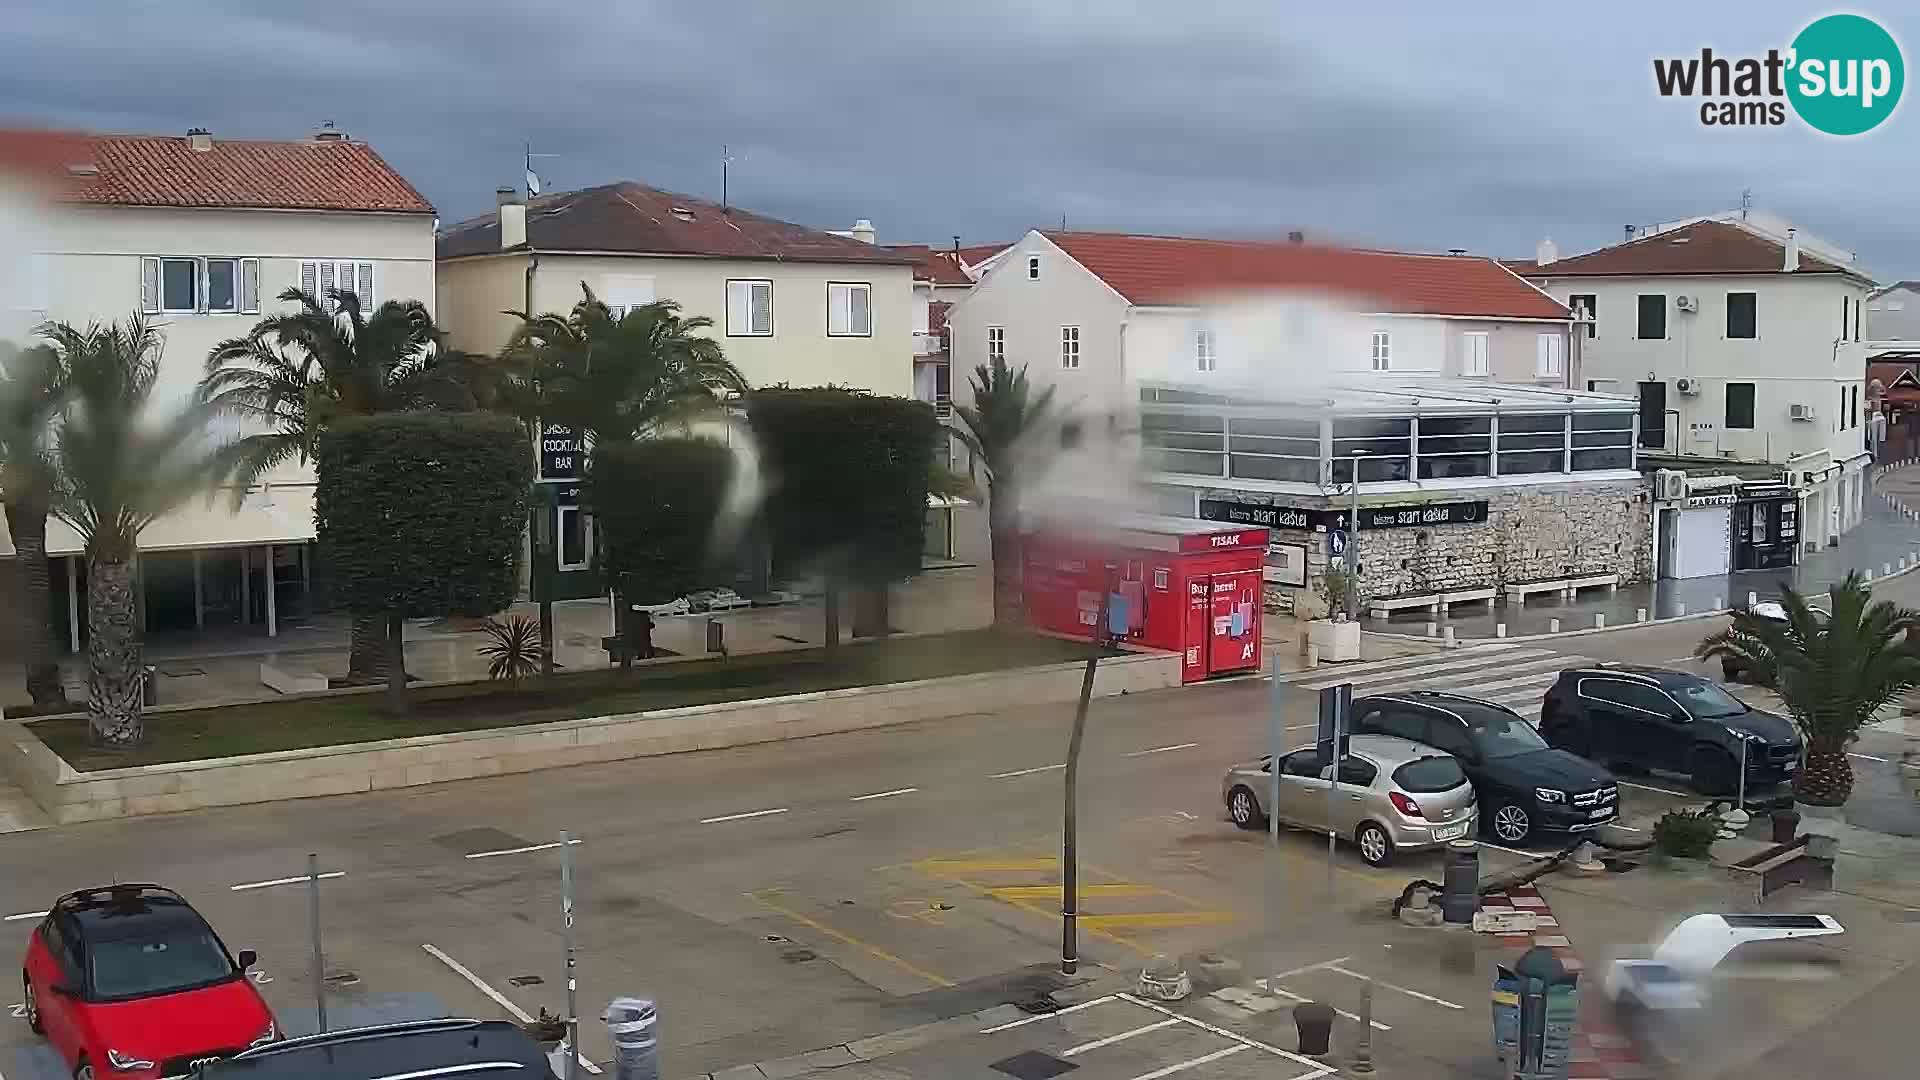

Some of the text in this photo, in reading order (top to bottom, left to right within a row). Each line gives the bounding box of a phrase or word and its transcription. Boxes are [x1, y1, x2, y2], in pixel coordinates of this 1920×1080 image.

[555, 456, 572, 469] BAR
[1689, 496, 1729, 507] MARKET
[1210, 535, 1240, 547] TISAK
[1191, 583, 1208, 596] Buy
